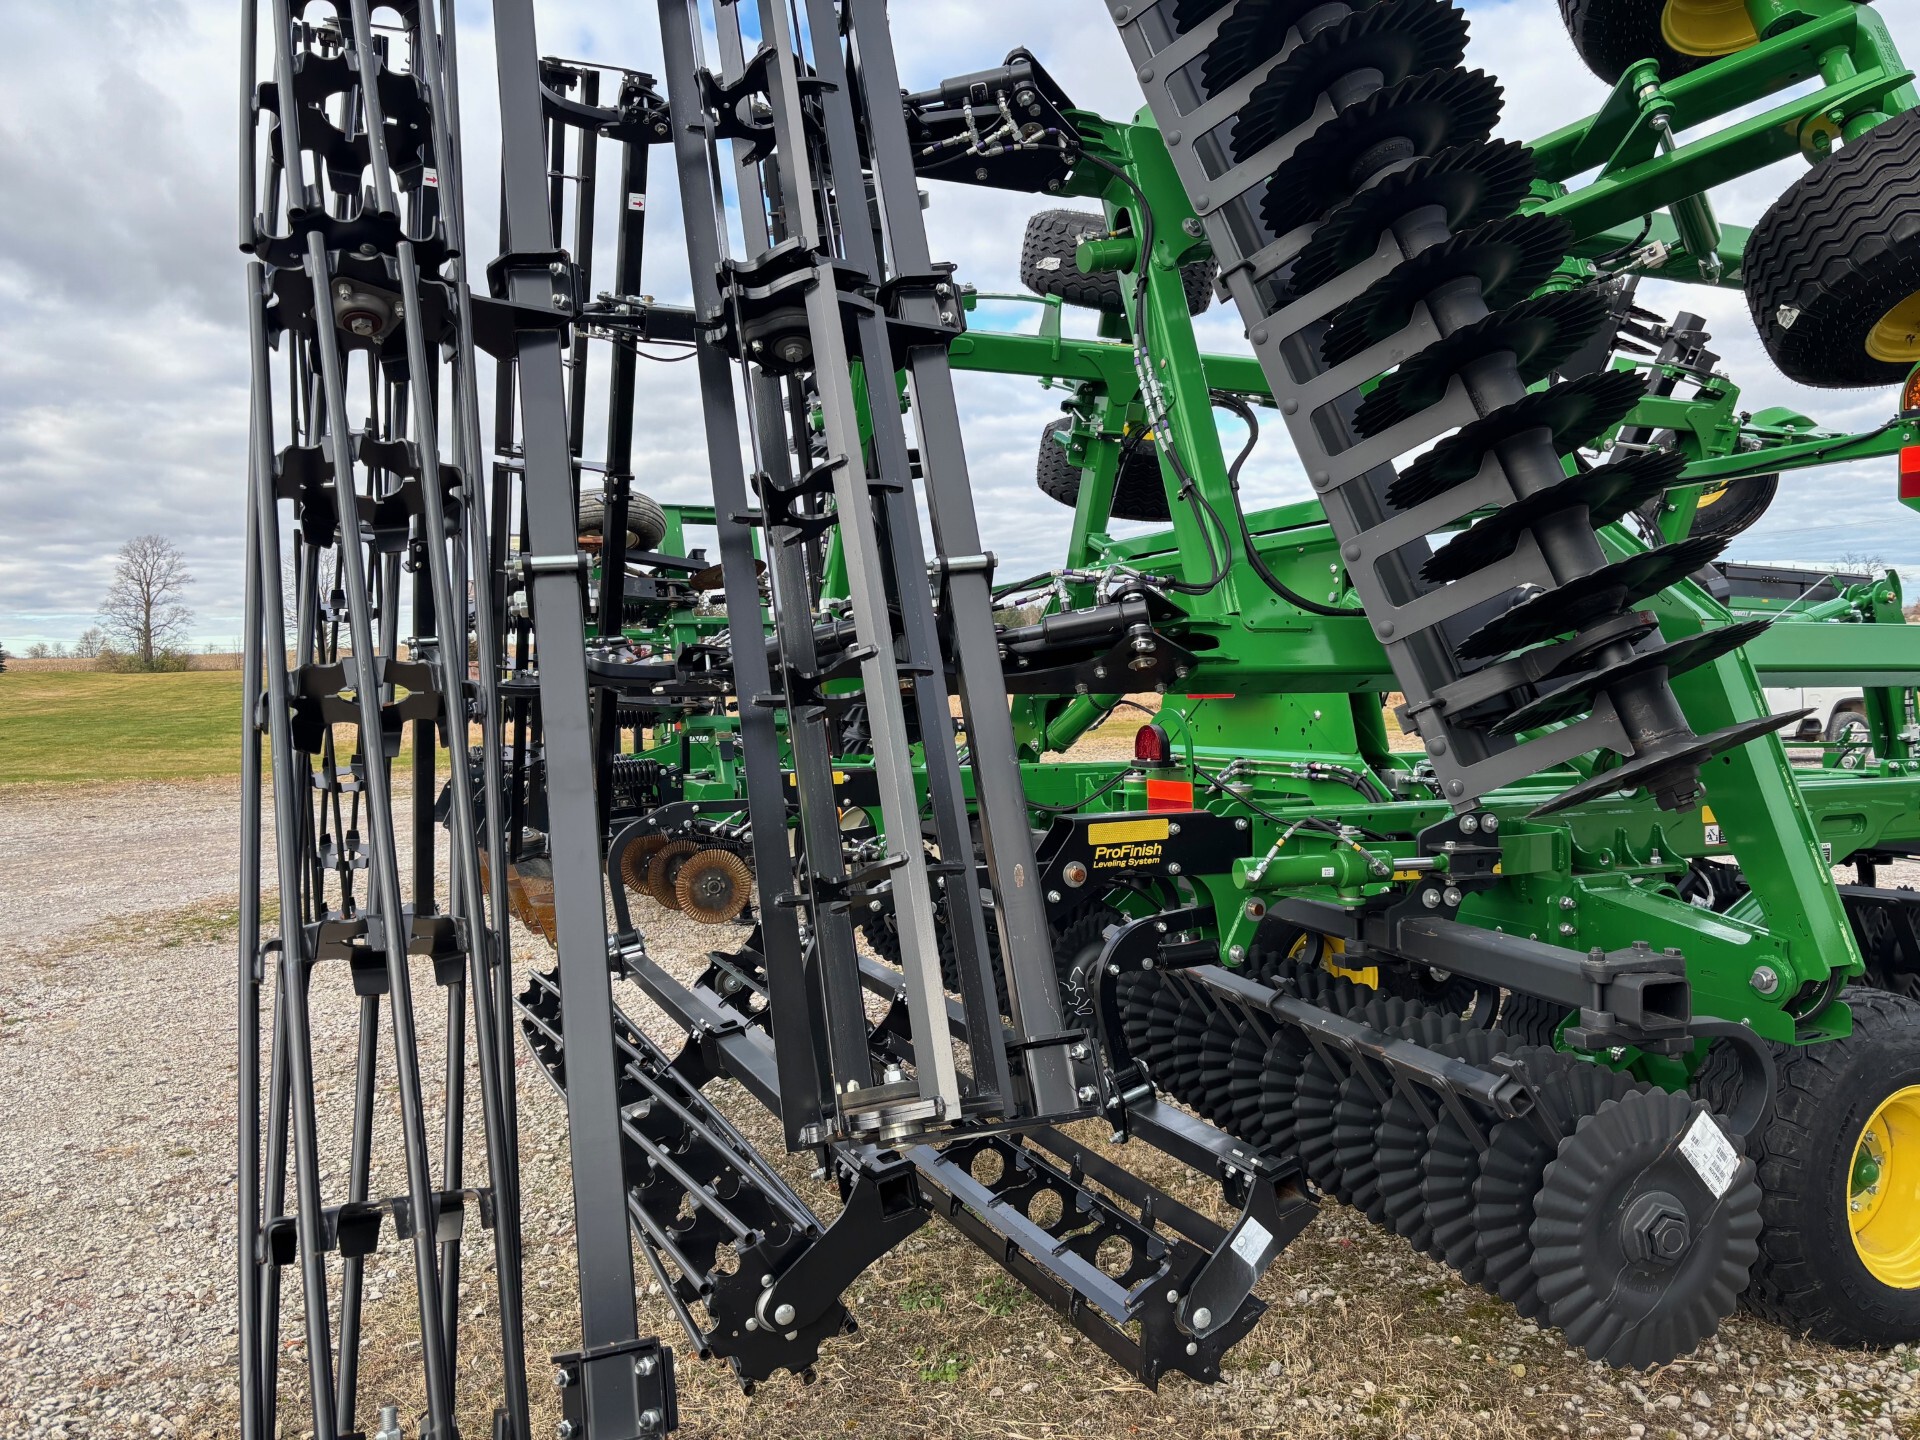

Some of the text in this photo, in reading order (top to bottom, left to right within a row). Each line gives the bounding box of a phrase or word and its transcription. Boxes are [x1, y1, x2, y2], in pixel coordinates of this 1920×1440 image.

[1094, 842, 1163, 860] ProFinish
[1092, 857, 1160, 869] Leveling System
